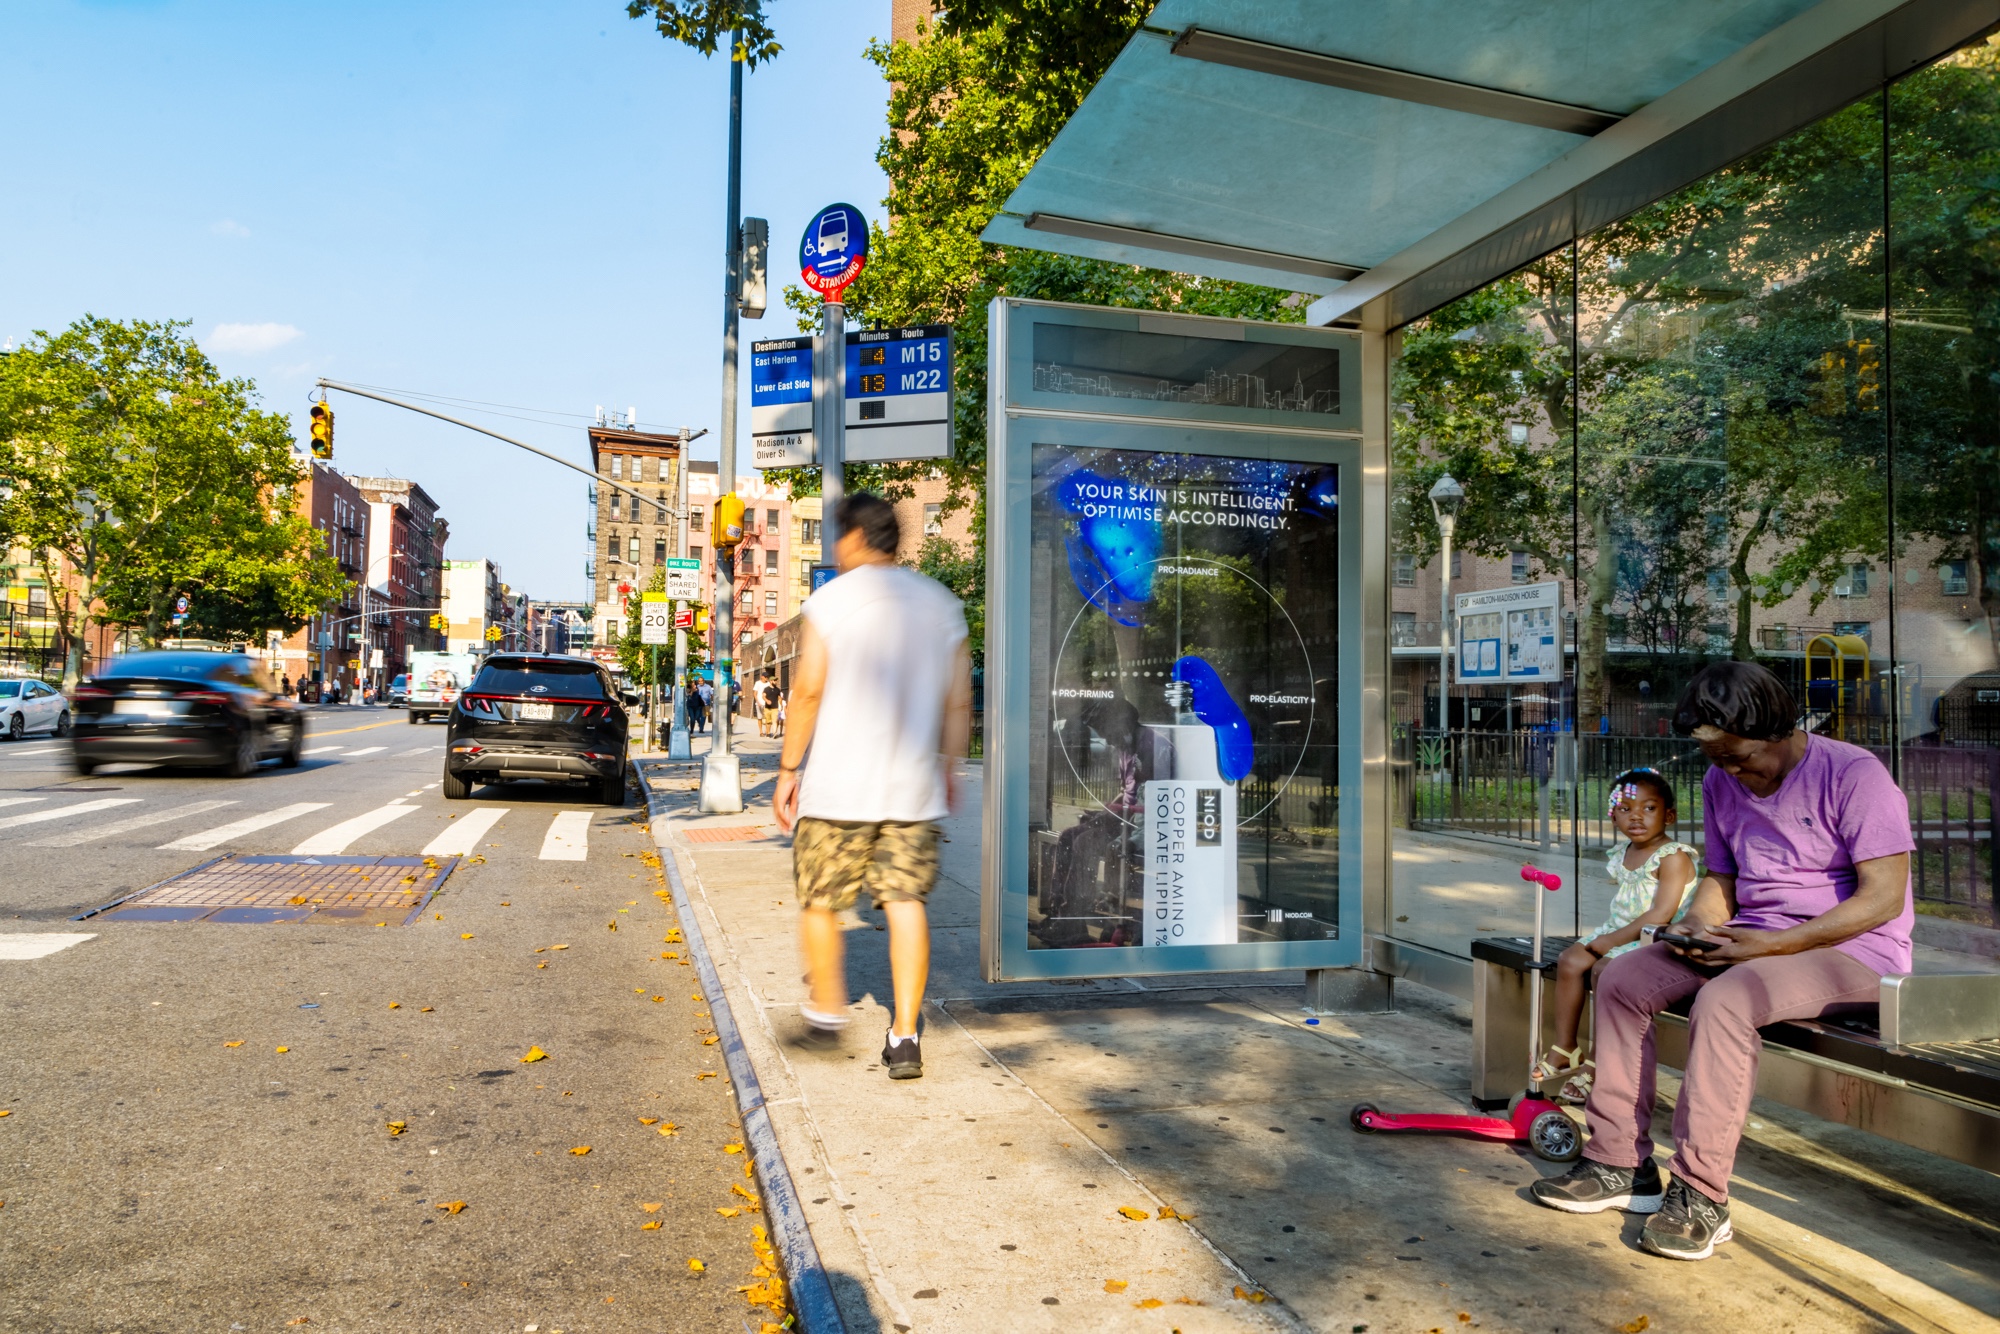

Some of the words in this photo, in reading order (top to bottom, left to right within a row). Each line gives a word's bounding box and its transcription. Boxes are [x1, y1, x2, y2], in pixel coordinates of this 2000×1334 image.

[806, 270, 818, 285] NO
[818, 261, 860, 289] STANDING
[859, 332, 890, 342] Minutes
[901, 328, 924, 338] Route
[755, 340, 796, 352] Destination
[901, 342, 941, 364] M15
[755, 358, 770, 366] East
[772, 355, 798, 365] Harlem
[874, 348, 885, 364] 4
[755, 384, 776, 393] Lower
[777, 382, 793, 391] East
[794, 380, 810, 389] Side
[863, 374, 885, 392] 13
[901, 369, 941, 391] M22
[756, 438, 785, 448] Madison
[786, 436, 796, 446] Av
[796, 436, 803, 445] &
[756, 450, 776, 460] Oliver
[778, 449, 786, 458] St
[1075, 483, 1123, 500] YOUR
[1129, 487, 1167, 503] SKIN
[1173, 490, 1187, 504] IS
[1192, 491, 1298, 512] INTELLIGENT.
[1084, 503, 1163, 522] OPTIMISE
[1167, 509, 1291, 530] ACCORDINGLY.
[682, 560, 698, 568] ROUTE
[1158, 565, 1219, 577] PRO-RADIANCE
[669, 580, 697, 588] SHARED
[1460, 598, 1470, 608] 50
[1472, 592, 1520, 606] HAMILTON-MADISON
[1520, 590, 1540, 600] HOUSE
[645, 615, 666, 626] 20
[1058, 688, 1115, 699] PRO-FIRMING
[1250, 694, 1310, 704] PRO-ELASTICITY
[1156, 787, 1170, 864] ISOLATE
[1172, 787, 1186, 864] COPPER
[1204, 796, 1216, 840] NIOD
[1156, 872, 1168, 920] LIPID
[1172, 870, 1184, 938] AMINO
[1155, 926, 1168, 946] 1%
[1601, 1172, 1625, 1190] N
[1702, 1207, 1719, 1226] N
